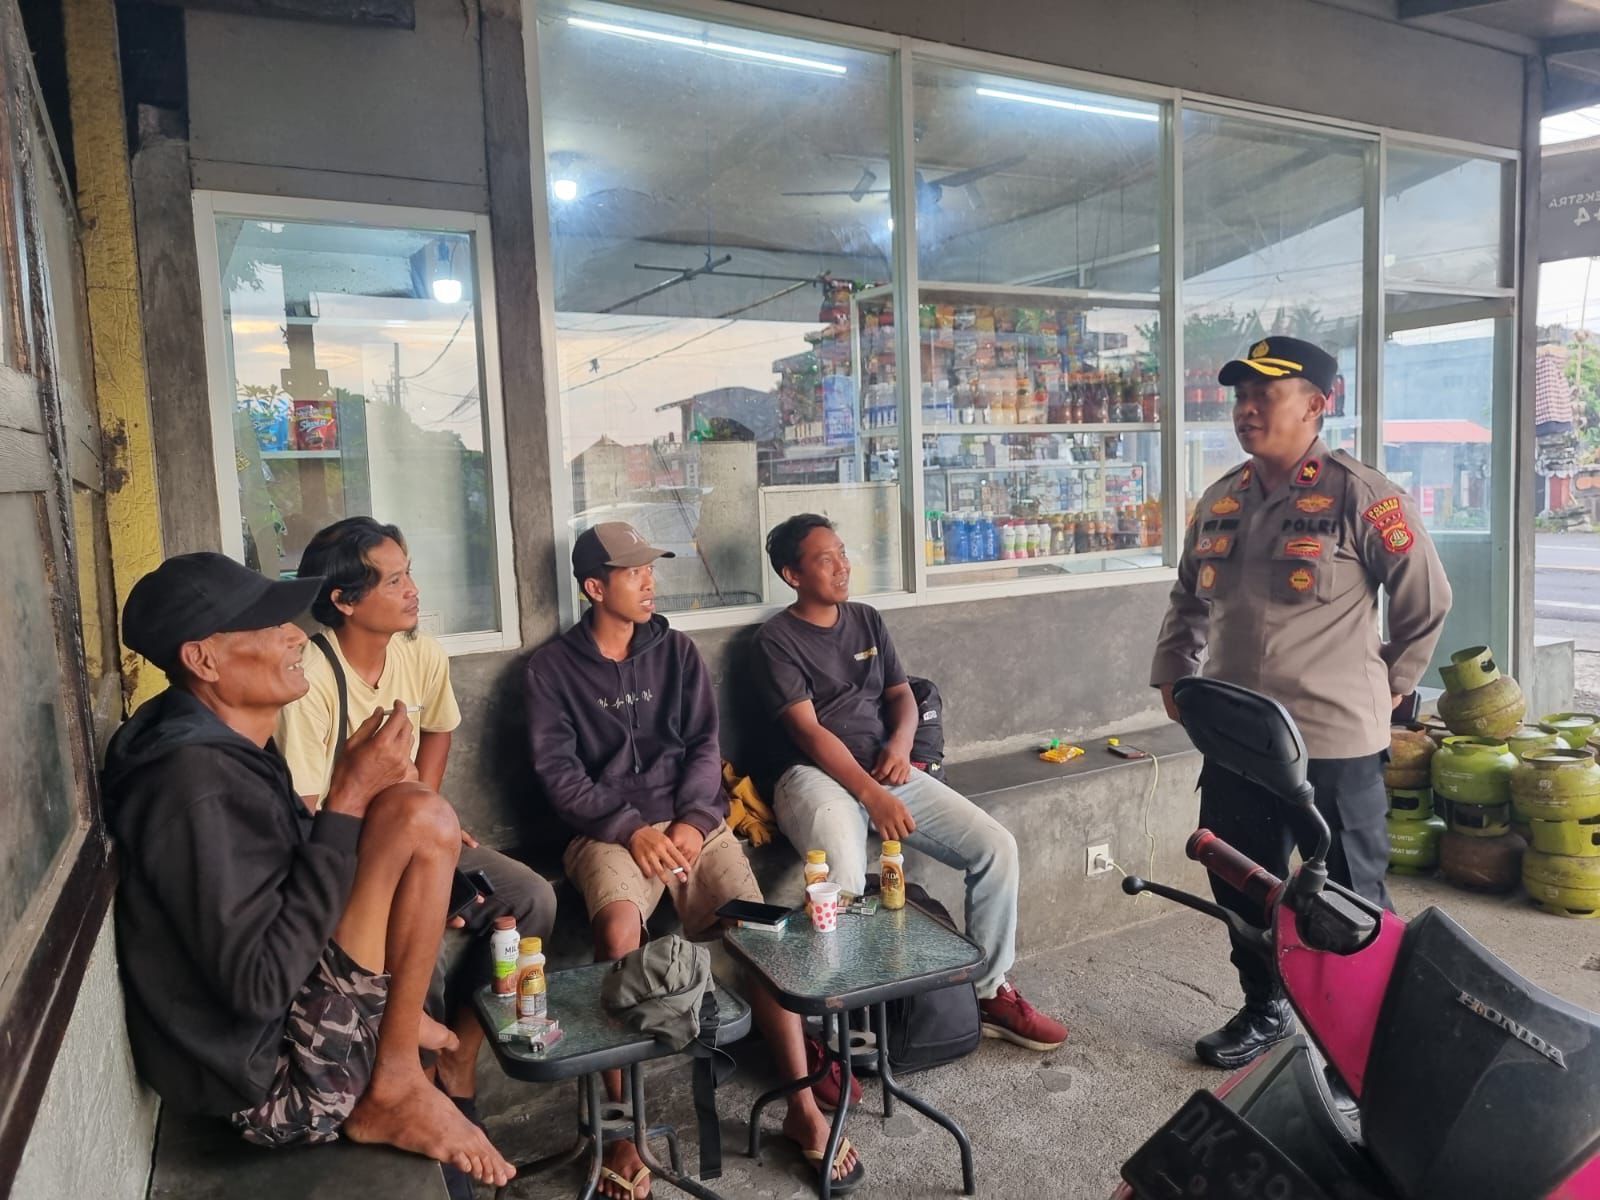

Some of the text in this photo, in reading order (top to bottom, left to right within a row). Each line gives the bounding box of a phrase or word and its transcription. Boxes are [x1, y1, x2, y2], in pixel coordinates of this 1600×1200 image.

[1281, 518, 1337, 535] POLRI
[1456, 991, 1568, 1071] HONDA
[1169, 1101, 1238, 1168] DK
